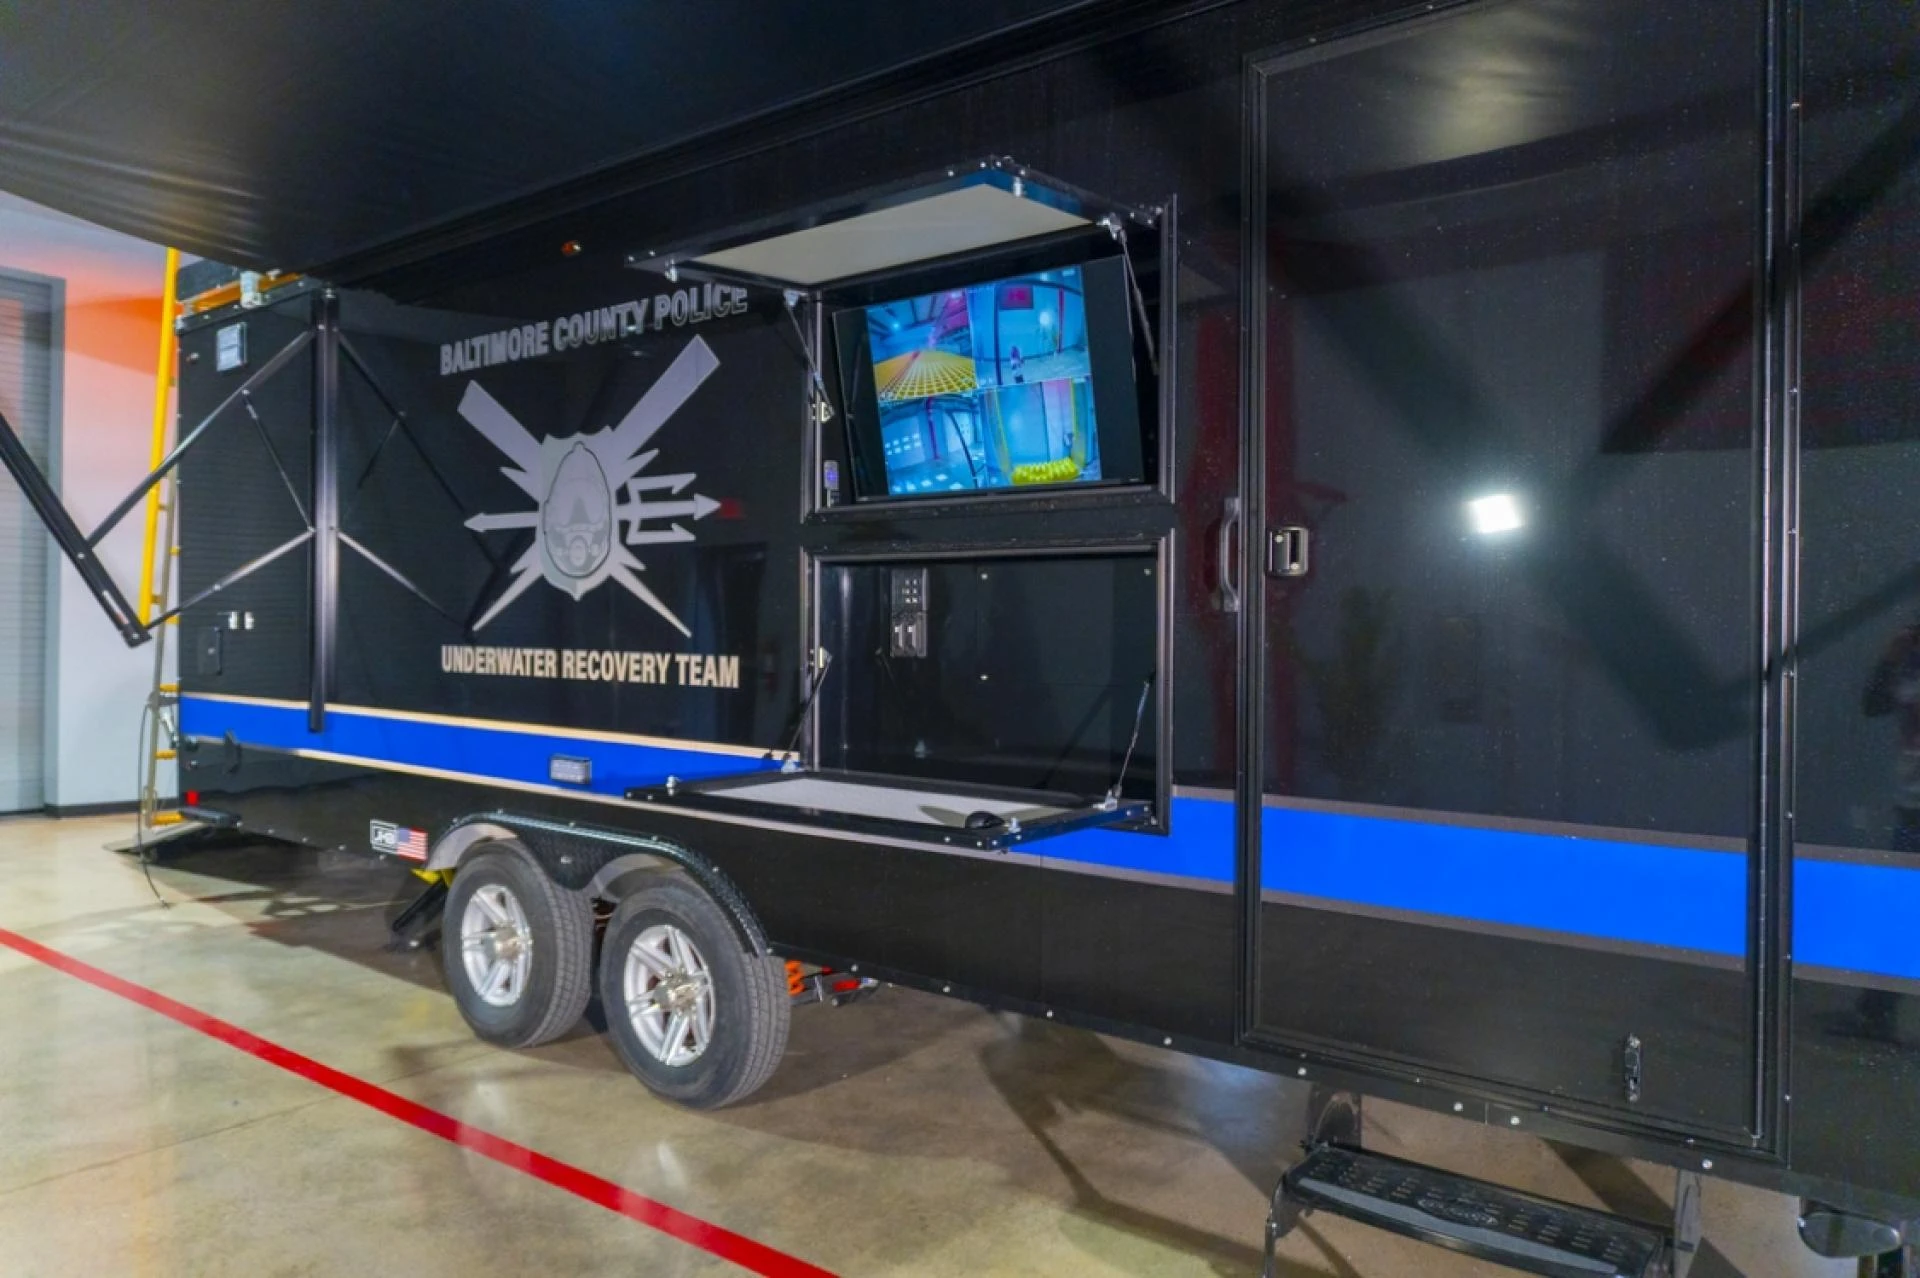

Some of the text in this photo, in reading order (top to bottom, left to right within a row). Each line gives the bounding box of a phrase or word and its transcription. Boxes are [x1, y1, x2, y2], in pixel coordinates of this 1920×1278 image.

[440, 283, 748, 376] BALTIMORE COUNTY POLICE
[441, 645, 739, 688] UNDERWATER RECOVERY TEAM
